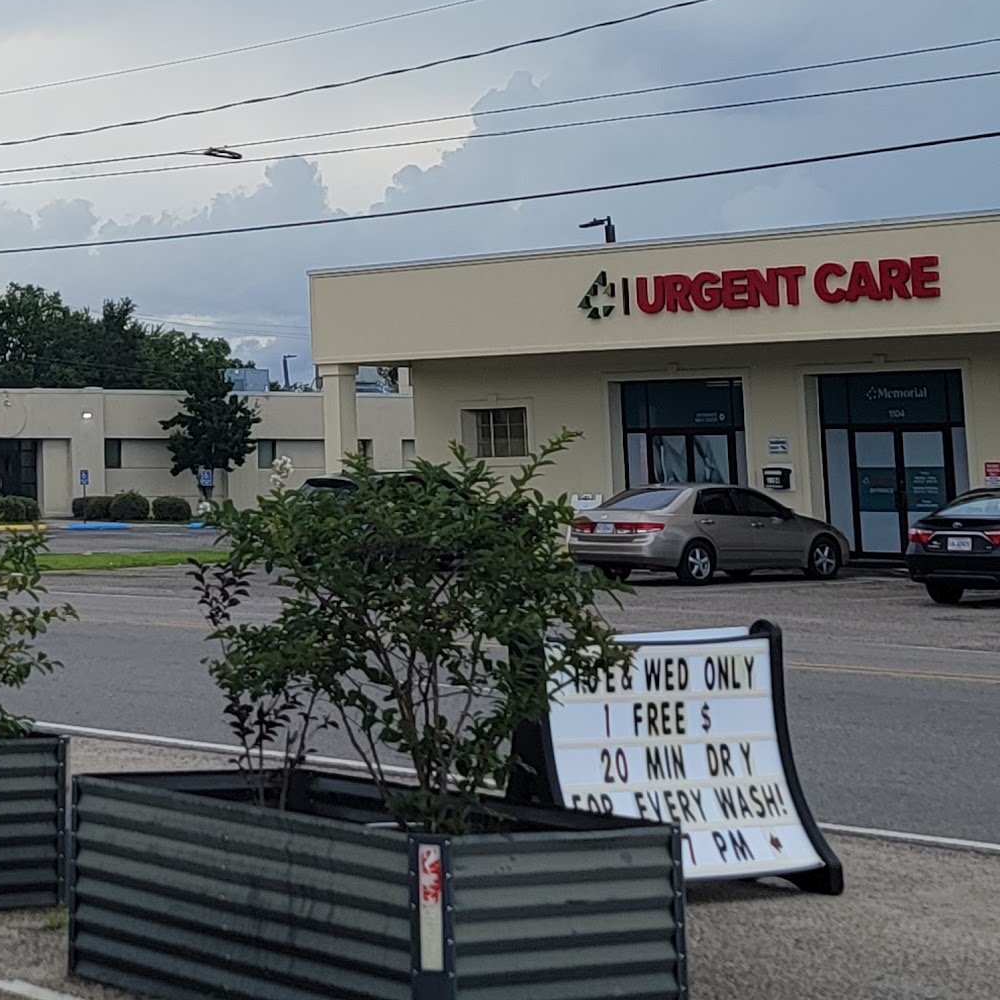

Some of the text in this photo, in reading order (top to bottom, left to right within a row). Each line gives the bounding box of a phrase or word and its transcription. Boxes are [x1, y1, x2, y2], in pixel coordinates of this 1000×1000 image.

[636, 255, 941, 314] URGENT CARE
[878, 387, 927, 399] Memorial
[644, 657, 688, 691] WED
[704, 656, 755, 690] ONLY
[603, 702, 712, 738] 1 FREE $
[600, 748, 628, 783] 20
[646, 745, 687, 780] MIN
[634, 789, 707, 823] EVERY
[714, 783, 788, 820] WASH!
[711, 829, 755, 863] PM
